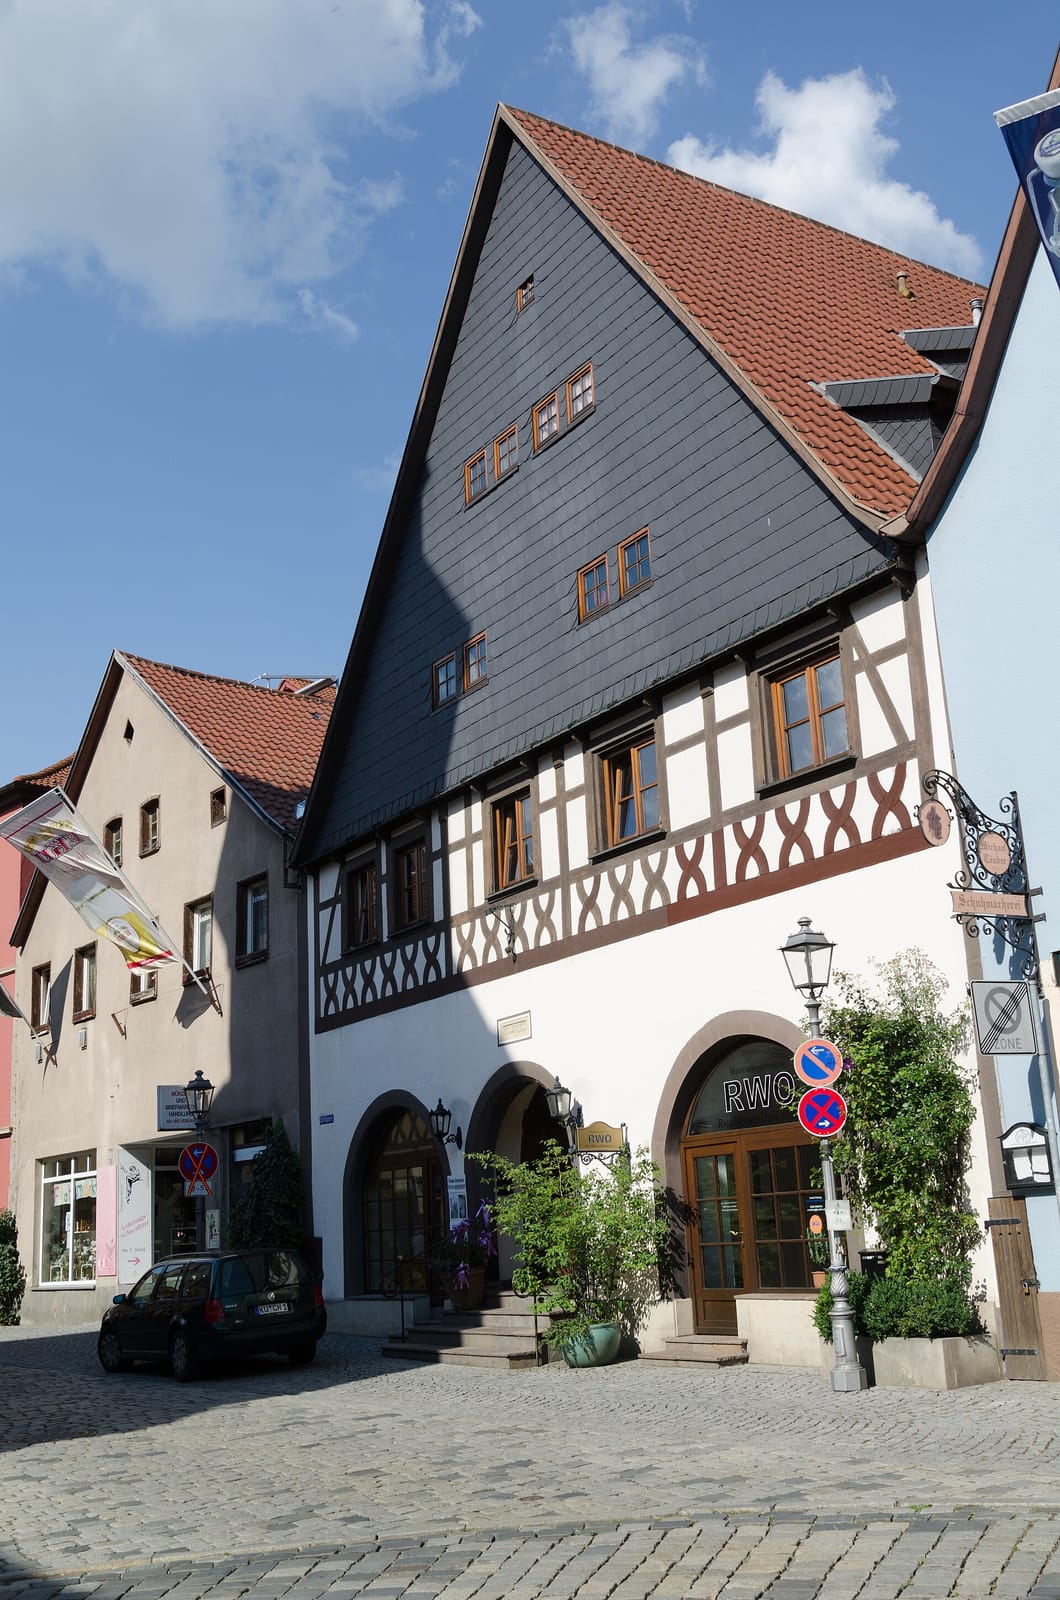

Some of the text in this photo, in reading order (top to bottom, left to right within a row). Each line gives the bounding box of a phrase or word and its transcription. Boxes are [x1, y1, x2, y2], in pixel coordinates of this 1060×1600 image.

[959, 894, 1021, 912] Schuhmacherei
[994, 1037, 1023, 1050] ZONE
[723, 1071, 796, 1113] RWO
[588, 1134, 612, 1144] RWO
